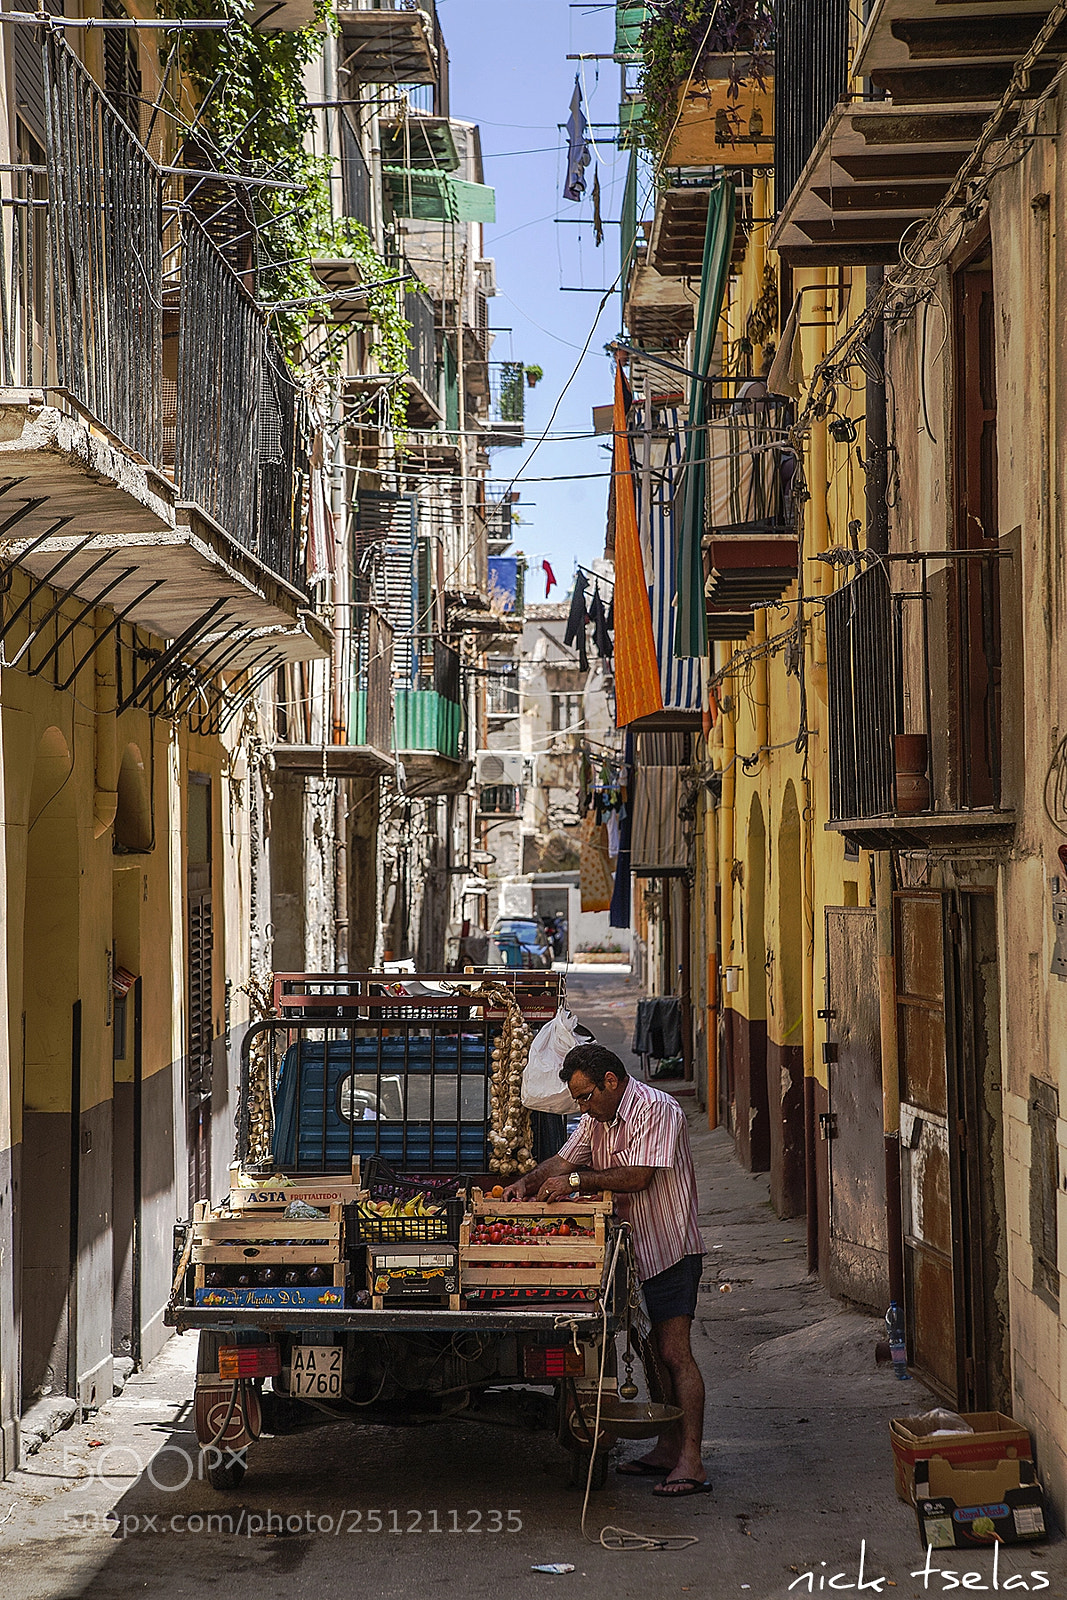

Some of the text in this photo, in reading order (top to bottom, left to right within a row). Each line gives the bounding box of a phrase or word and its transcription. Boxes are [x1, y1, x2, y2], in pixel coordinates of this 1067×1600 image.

[247, 1191, 287, 1203] ASTA
[479, 1289, 586, 1300] Verardi
[294, 1350, 341, 1371] AA 2
[295, 1373, 340, 1394] 1760
